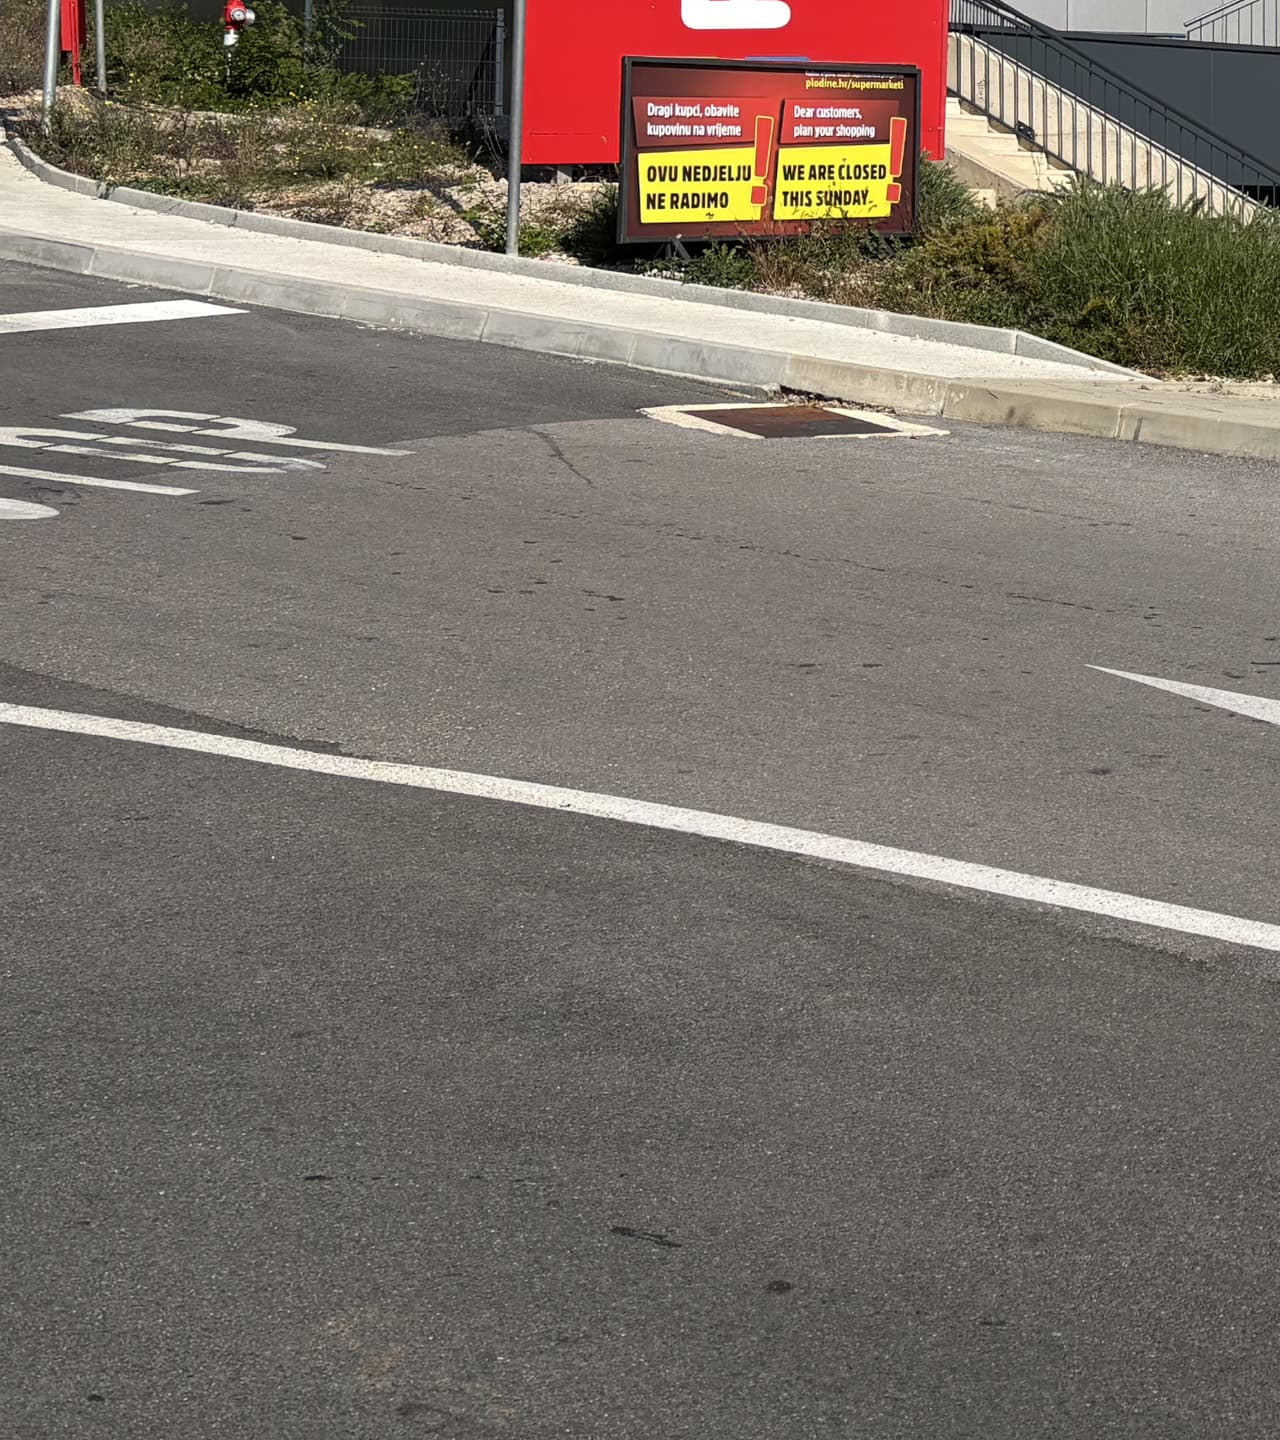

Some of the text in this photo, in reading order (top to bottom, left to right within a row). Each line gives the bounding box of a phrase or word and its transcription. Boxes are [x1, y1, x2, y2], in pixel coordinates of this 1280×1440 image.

[805, 78, 904, 91] plodine.hr/supermarketi
[647, 102, 740, 119] Dragi kupci, obavite
[793, 104, 863, 121] Dear customers,
[646, 122, 742, 139] kupovinu na vrijeme
[793, 123, 876, 139] plan your shopping
[646, 164, 752, 183] OVU NEDJELJU
[782, 163, 888, 182] WE ARE CLOSED
[646, 191, 730, 210] NE RADIMO
[782, 189, 869, 208] THIS SUNDAY
